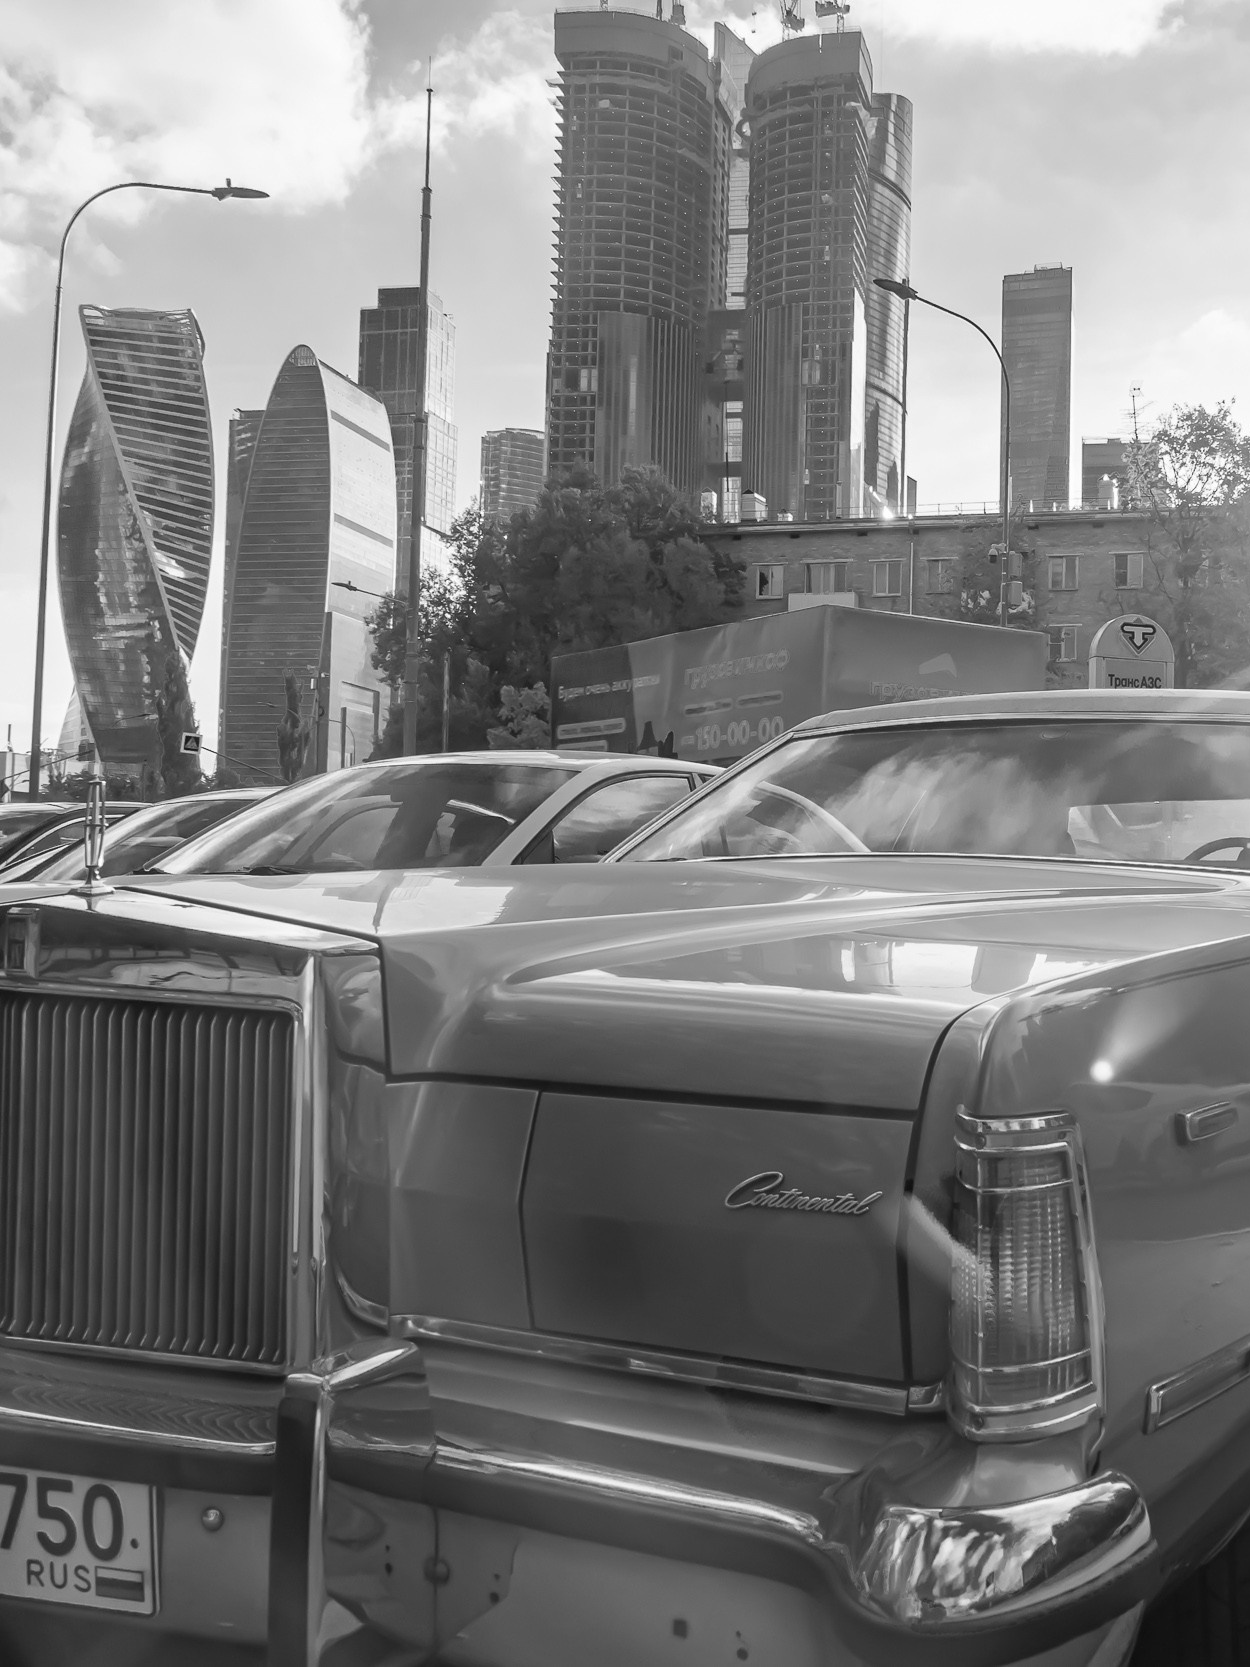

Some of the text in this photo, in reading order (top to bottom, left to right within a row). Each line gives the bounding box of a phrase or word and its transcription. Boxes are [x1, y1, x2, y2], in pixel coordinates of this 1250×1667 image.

[1107, 674, 1162, 689] ТрансАЗС
[724, 1171, 883, 1215] Continental
[26, 1559, 92, 1593] RUS
